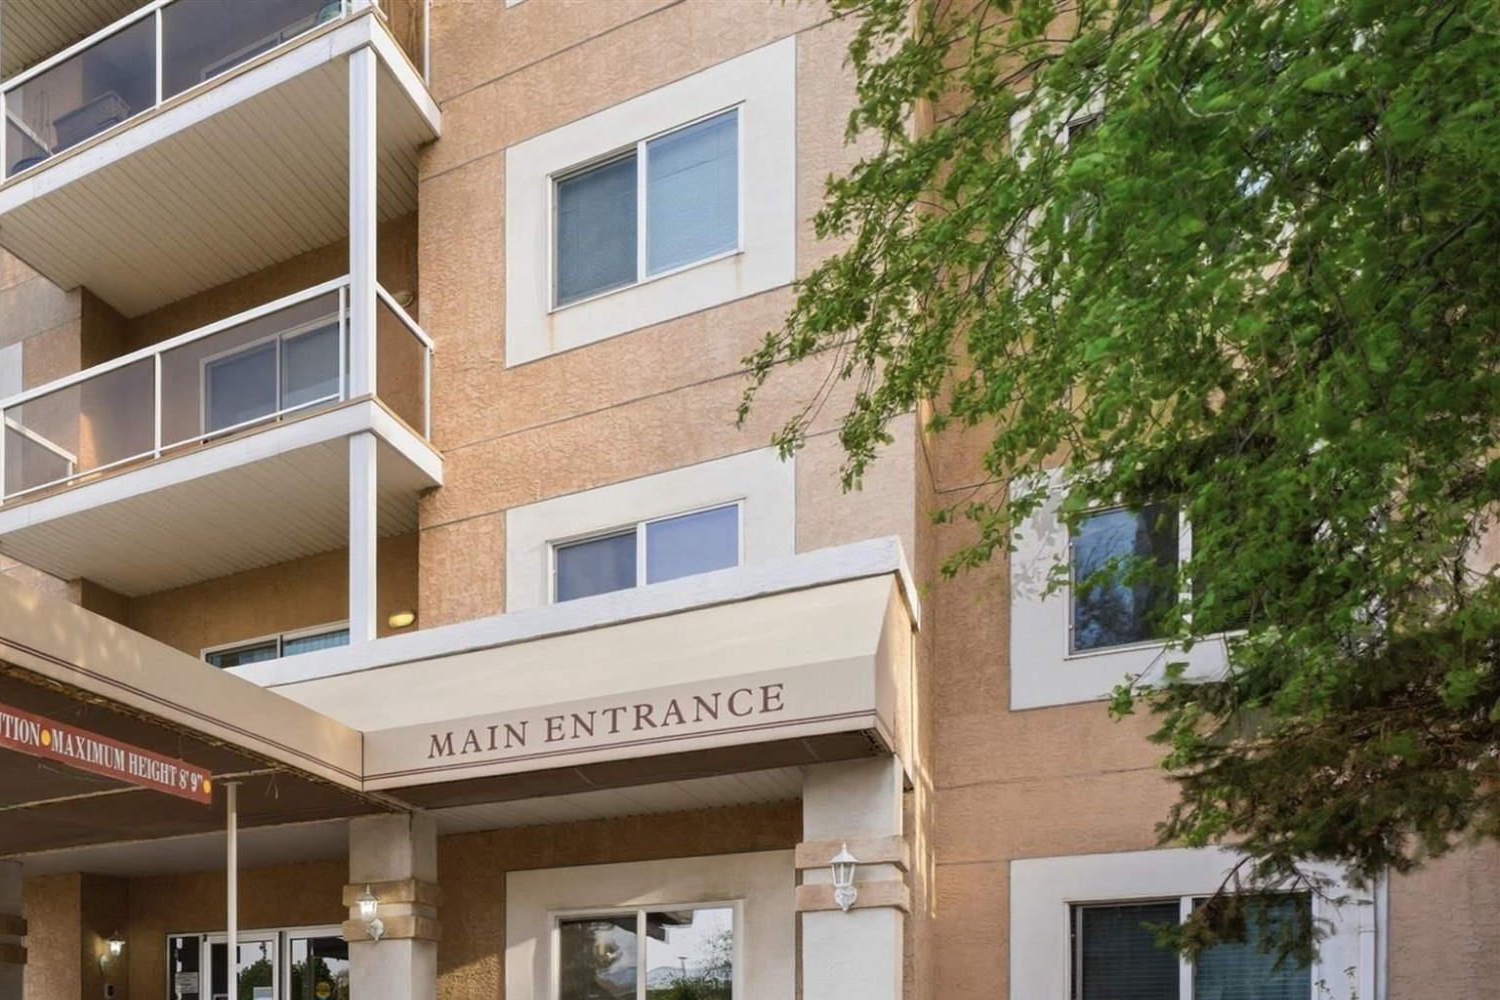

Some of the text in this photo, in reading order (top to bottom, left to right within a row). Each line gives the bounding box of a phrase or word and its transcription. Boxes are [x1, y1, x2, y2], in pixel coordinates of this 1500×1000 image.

[427, 682, 785, 760] MAIN ENTRANCE
[51, 728, 126, 773] MAXIMUM
[128, 752, 178, 787] HEIGHT
